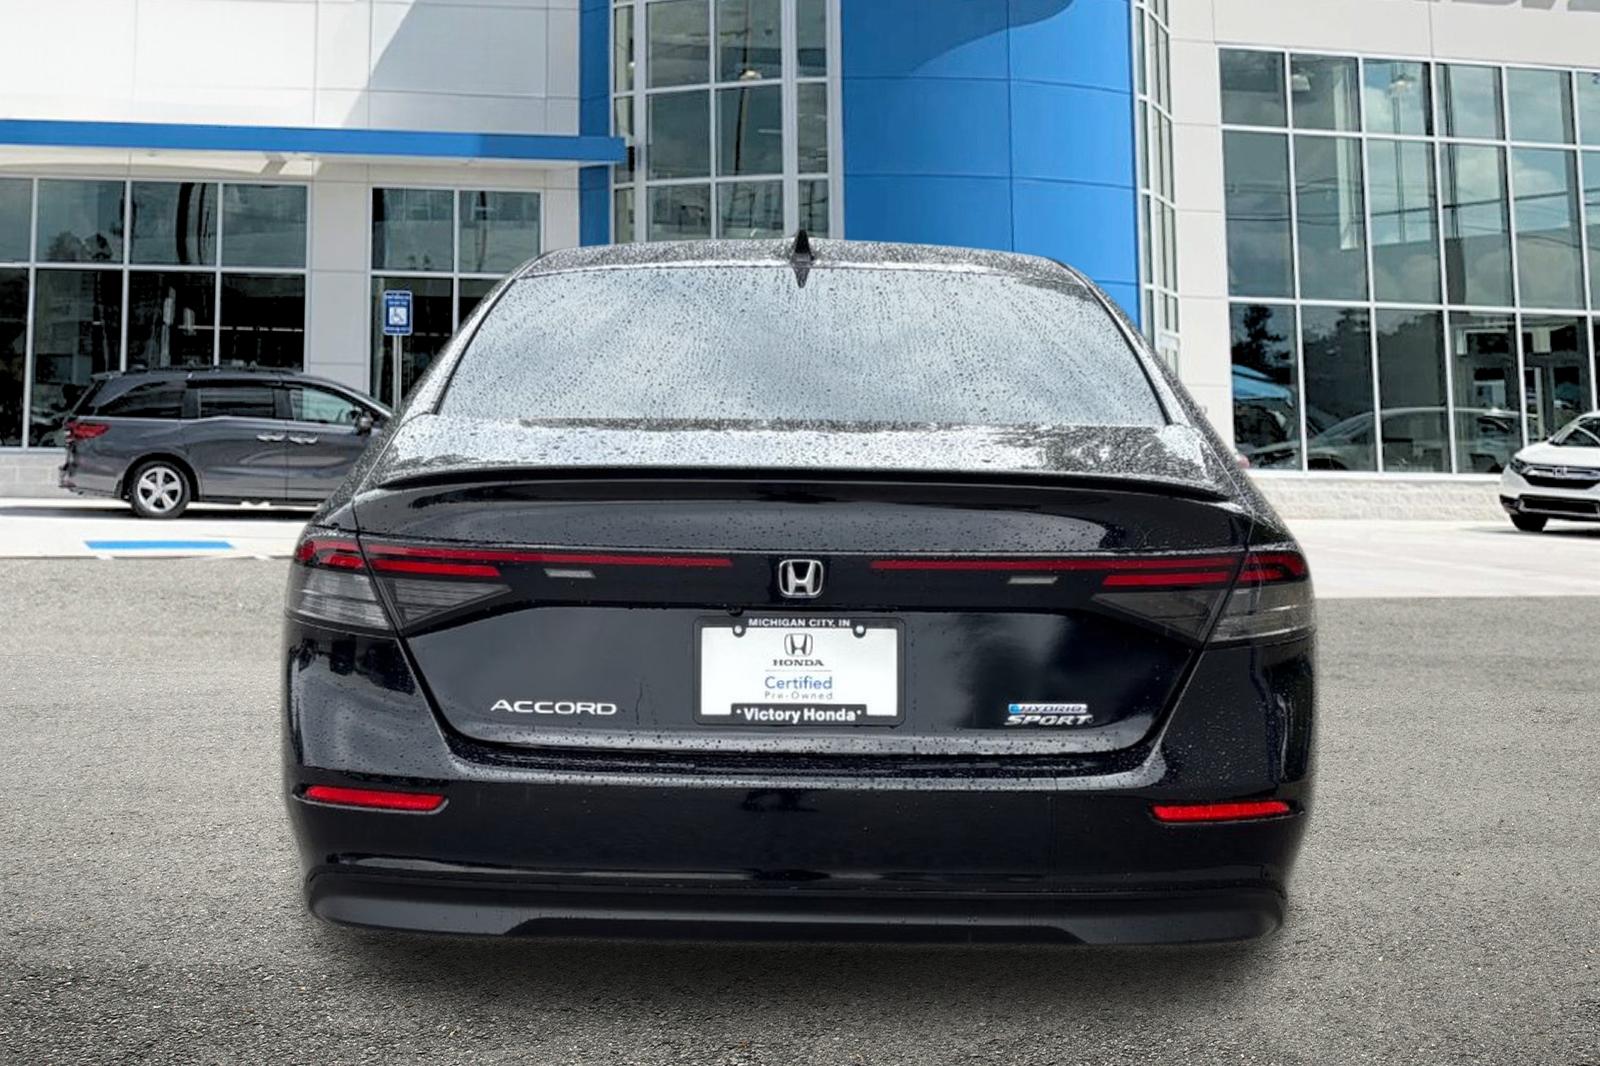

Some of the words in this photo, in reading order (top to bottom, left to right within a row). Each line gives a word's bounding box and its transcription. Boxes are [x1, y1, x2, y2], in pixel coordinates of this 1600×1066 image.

[748, 618, 806, 628] MICHIGAN
[809, 619, 835, 629] CITY,
[838, 619, 851, 628] IN
[772, 659, 824, 667] HONDA
[764, 676, 833, 690] Certified
[764, 691, 833, 700] Pre-Owned
[490, 699, 617, 715] ACCORD
[743, 707, 800, 724] Victory
[803, 708, 856, 721] Honda
[1004, 714, 1093, 725] SPORT
